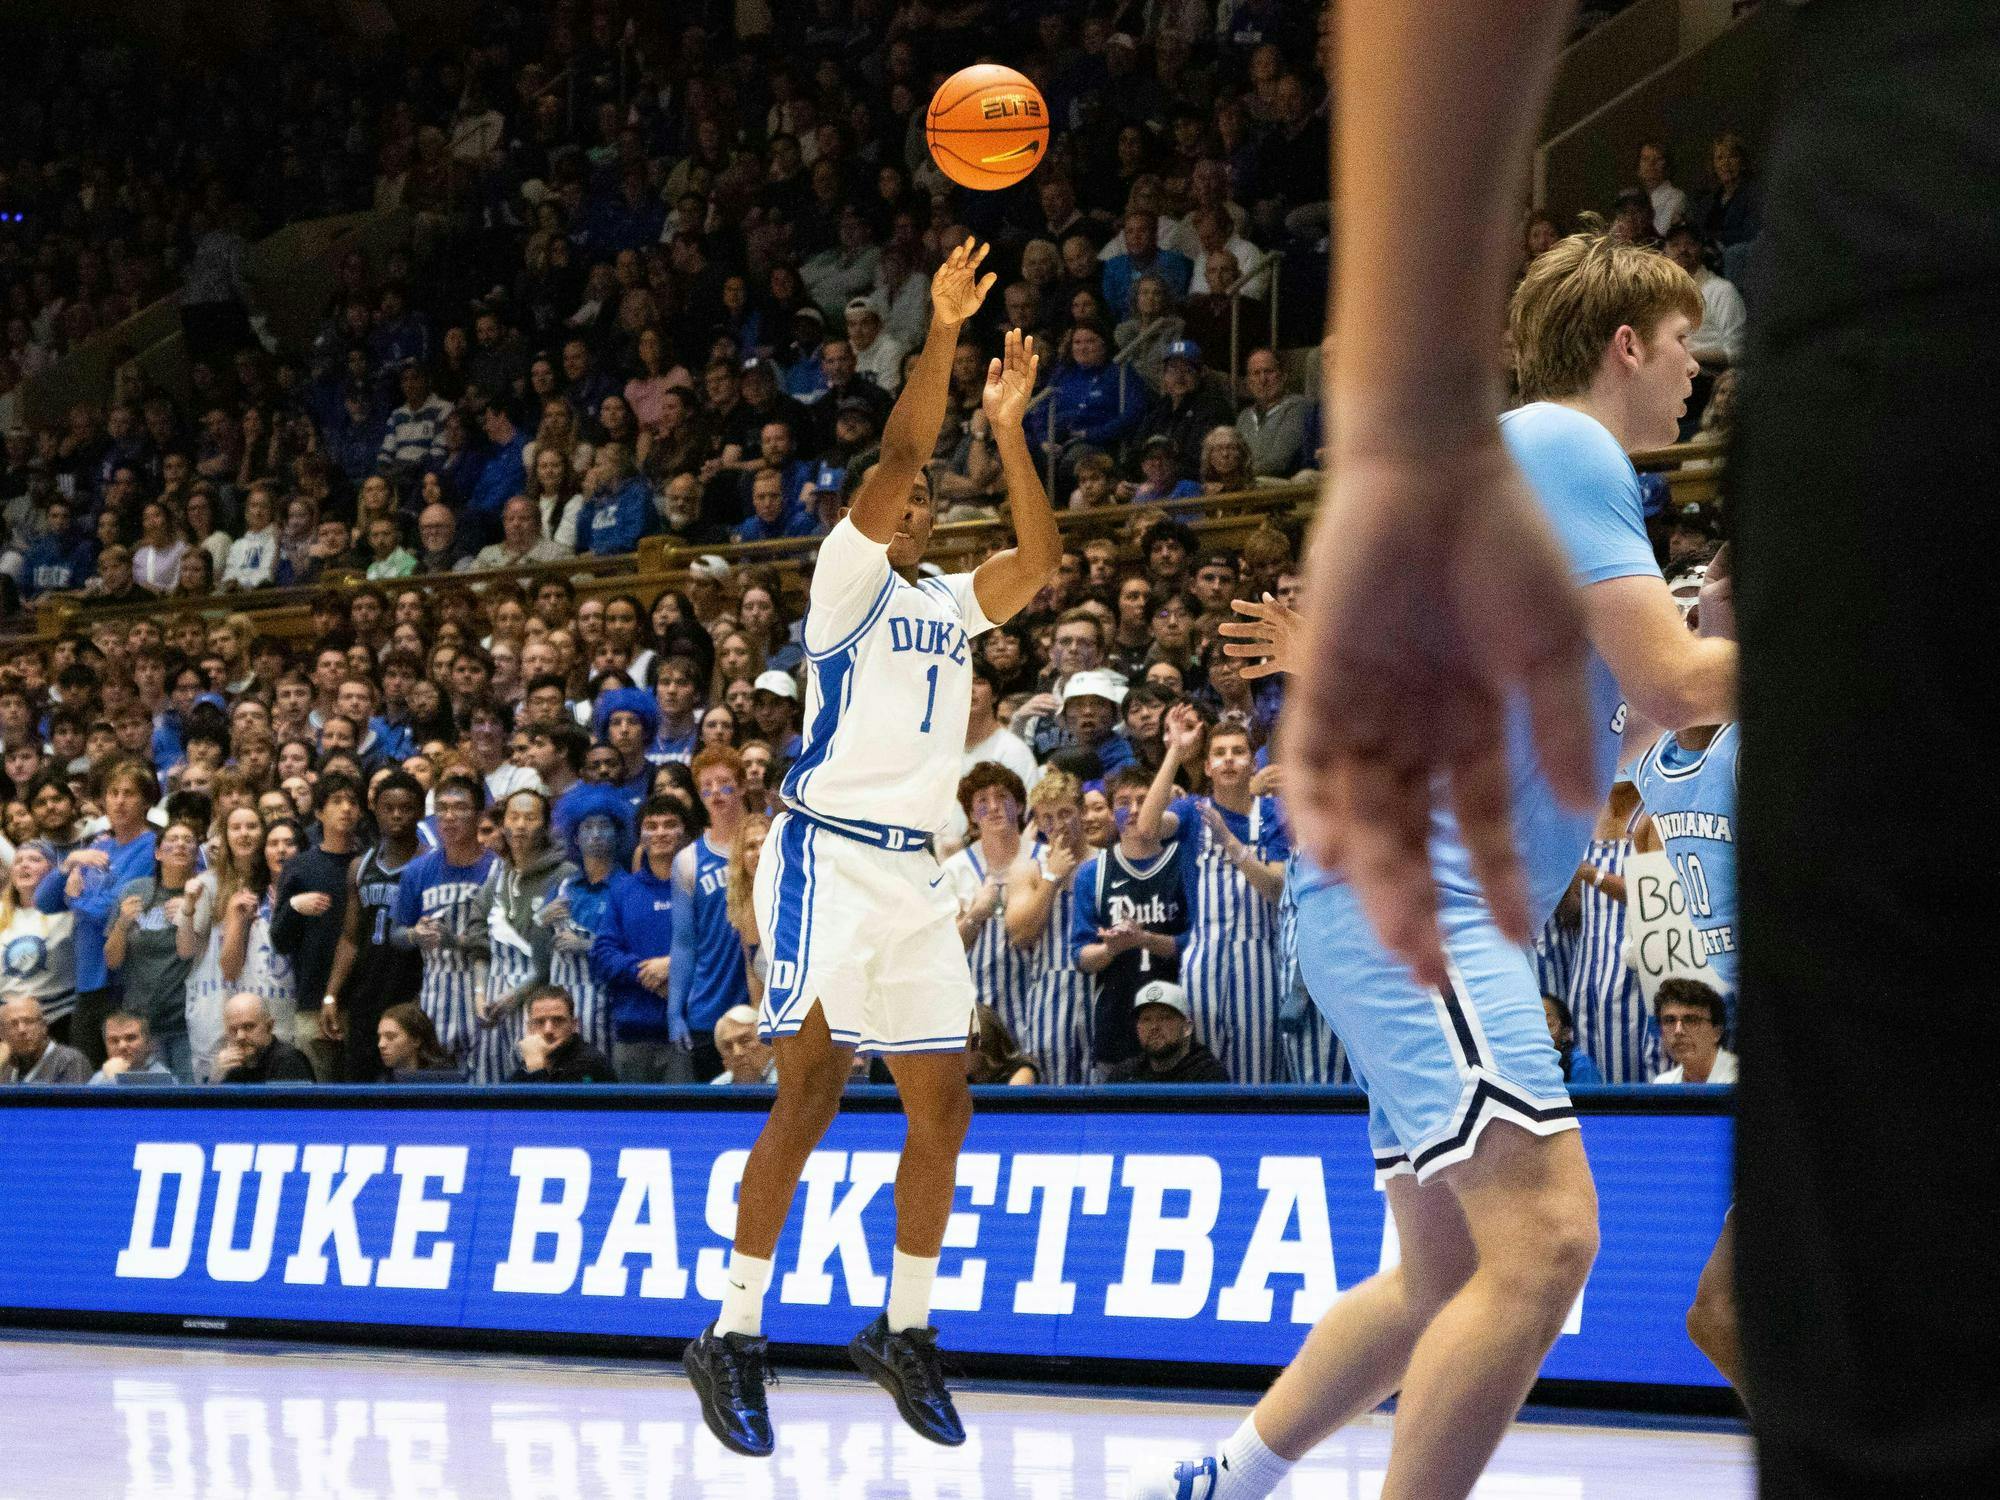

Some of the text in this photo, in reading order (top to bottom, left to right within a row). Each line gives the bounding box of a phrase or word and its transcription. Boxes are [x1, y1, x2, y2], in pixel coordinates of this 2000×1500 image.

[983, 100, 1041, 120] ELITE
[888, 617, 969, 667] DUKE
[920, 665, 938, 733] 1
[1651, 810, 1734, 844] INDIANA
[1676, 852, 1712, 918] 10
[1107, 893, 1181, 926] Duke
[1699, 924, 1737, 956] ATE
[115, 1142, 1582, 1335] DUKE BASKETBA
